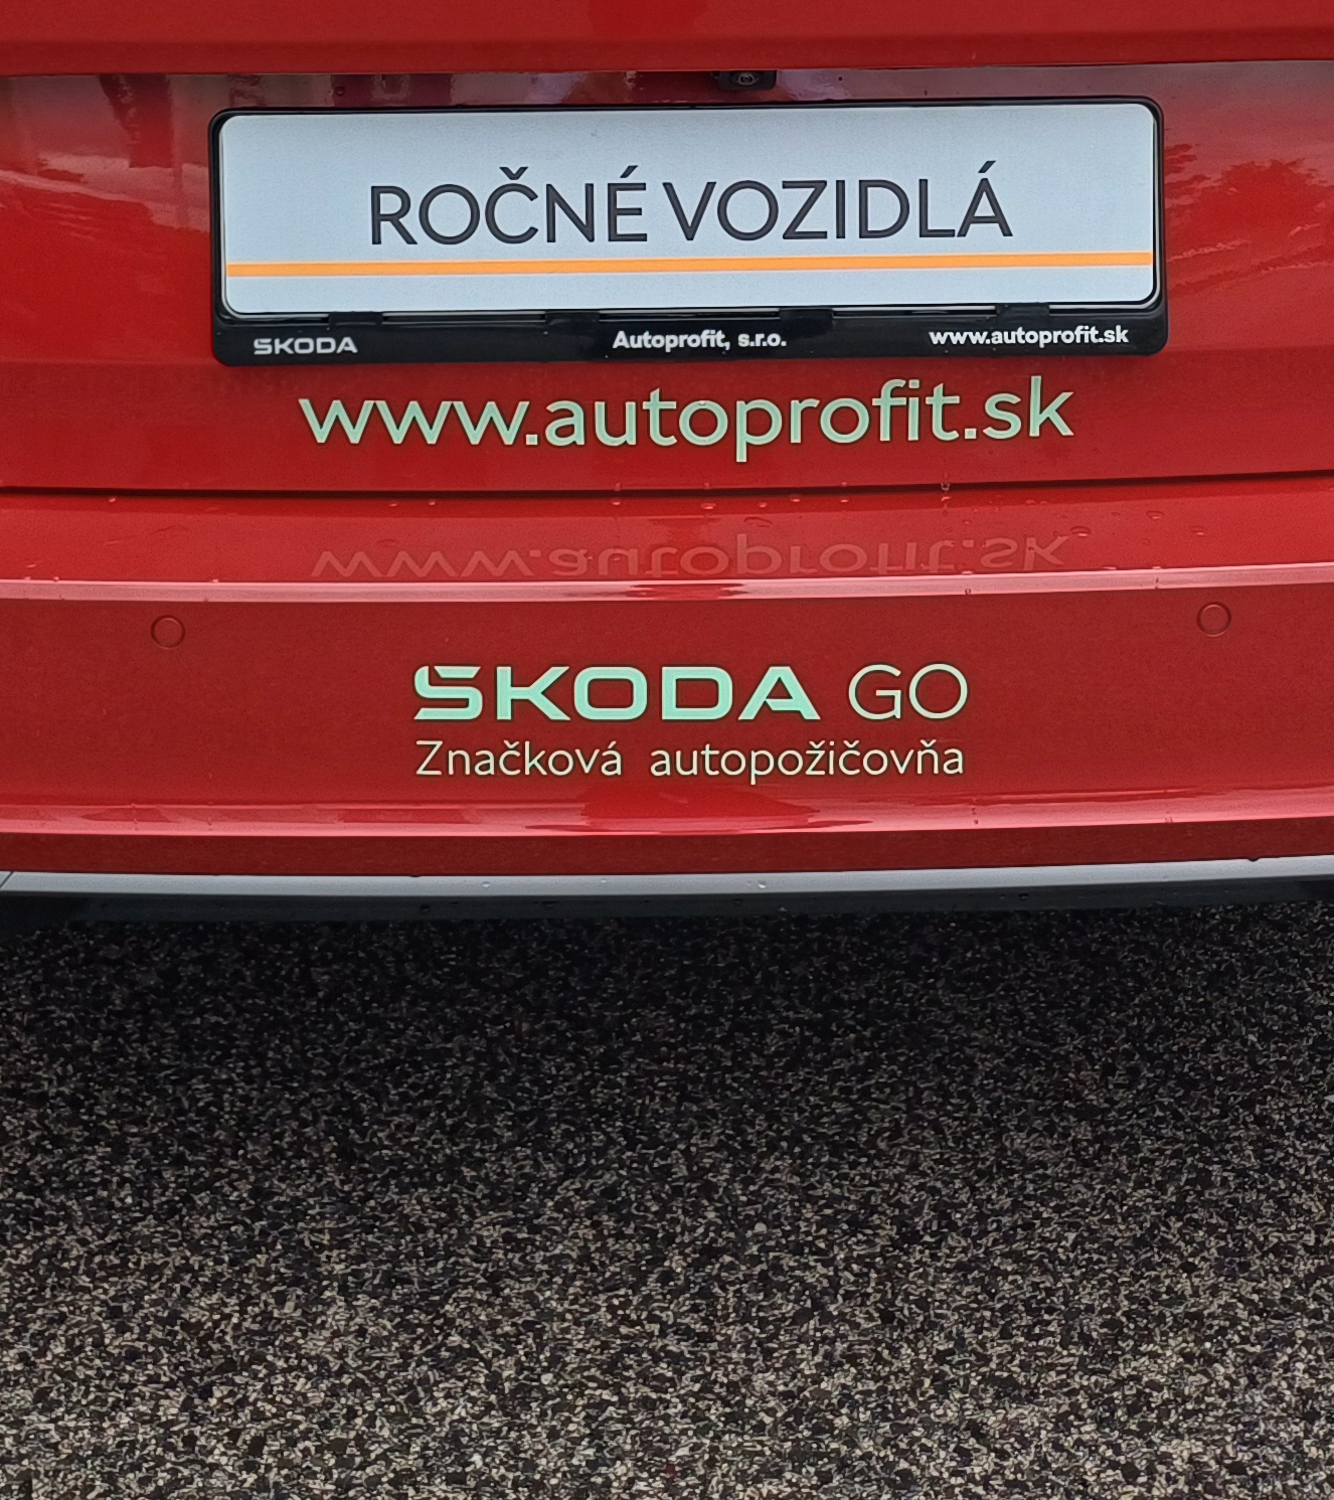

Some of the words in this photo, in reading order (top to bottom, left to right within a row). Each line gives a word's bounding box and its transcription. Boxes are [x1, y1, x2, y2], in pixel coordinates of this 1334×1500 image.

[370, 164, 648, 245] ROČNÉ
[662, 160, 1013, 241] VOZIDLÁ
[253, 336, 358, 355] SKODA
[612, 329, 731, 353] Autoprofit,
[737, 333, 787, 348] s.r.o.
[928, 324, 1130, 349] www.autoprofit.sk
[298, 375, 1074, 463] www.autoprofit.sk
[413, 665, 821, 721] SKODA
[848, 663, 968, 720] GO
[415, 739, 622, 776] Značková
[650, 739, 964, 786] autopožičovňa
